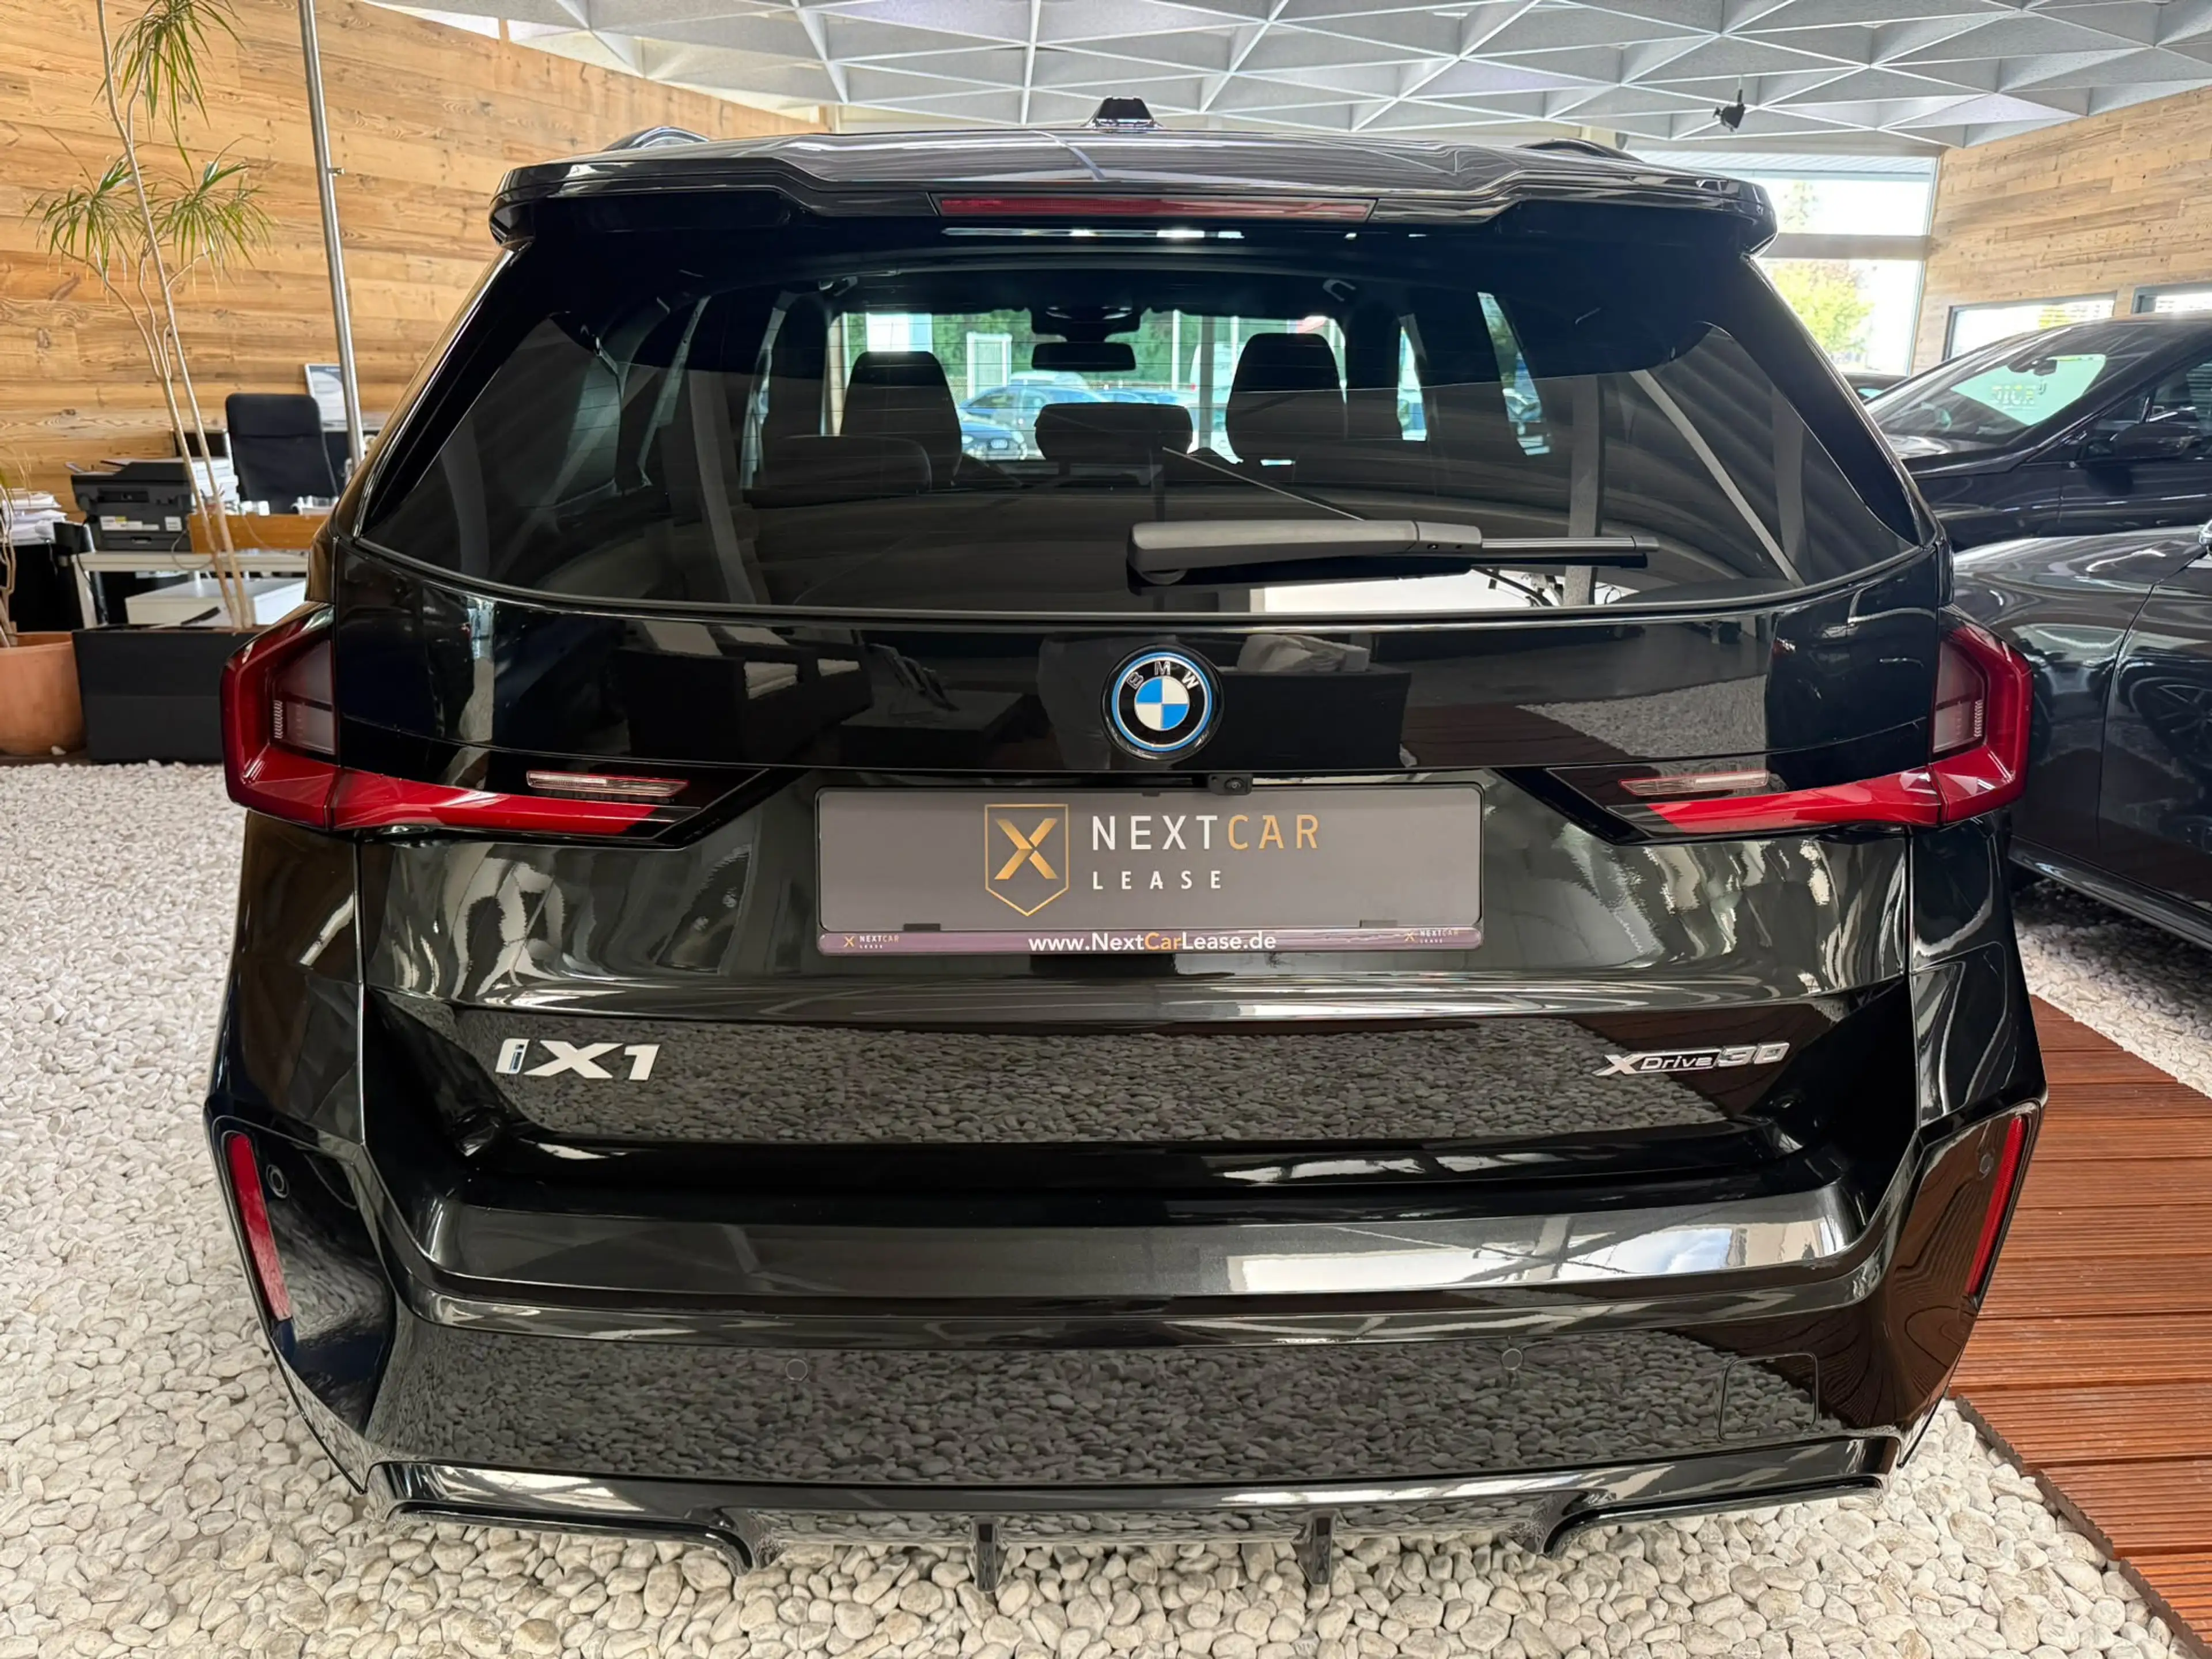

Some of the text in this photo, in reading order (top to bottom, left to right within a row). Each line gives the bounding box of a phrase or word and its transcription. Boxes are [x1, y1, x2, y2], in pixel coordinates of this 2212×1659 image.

[1126, 660, 1199, 690] BMW
[1092, 814, 1319, 850] NEXTCAR
[1093, 870, 1221, 890] LEASE
[859, 935, 900, 943] NEXTCAR
[1028, 931, 1277, 952] www.NextCarLease.de
[495, 1038, 661, 1081] iX1
